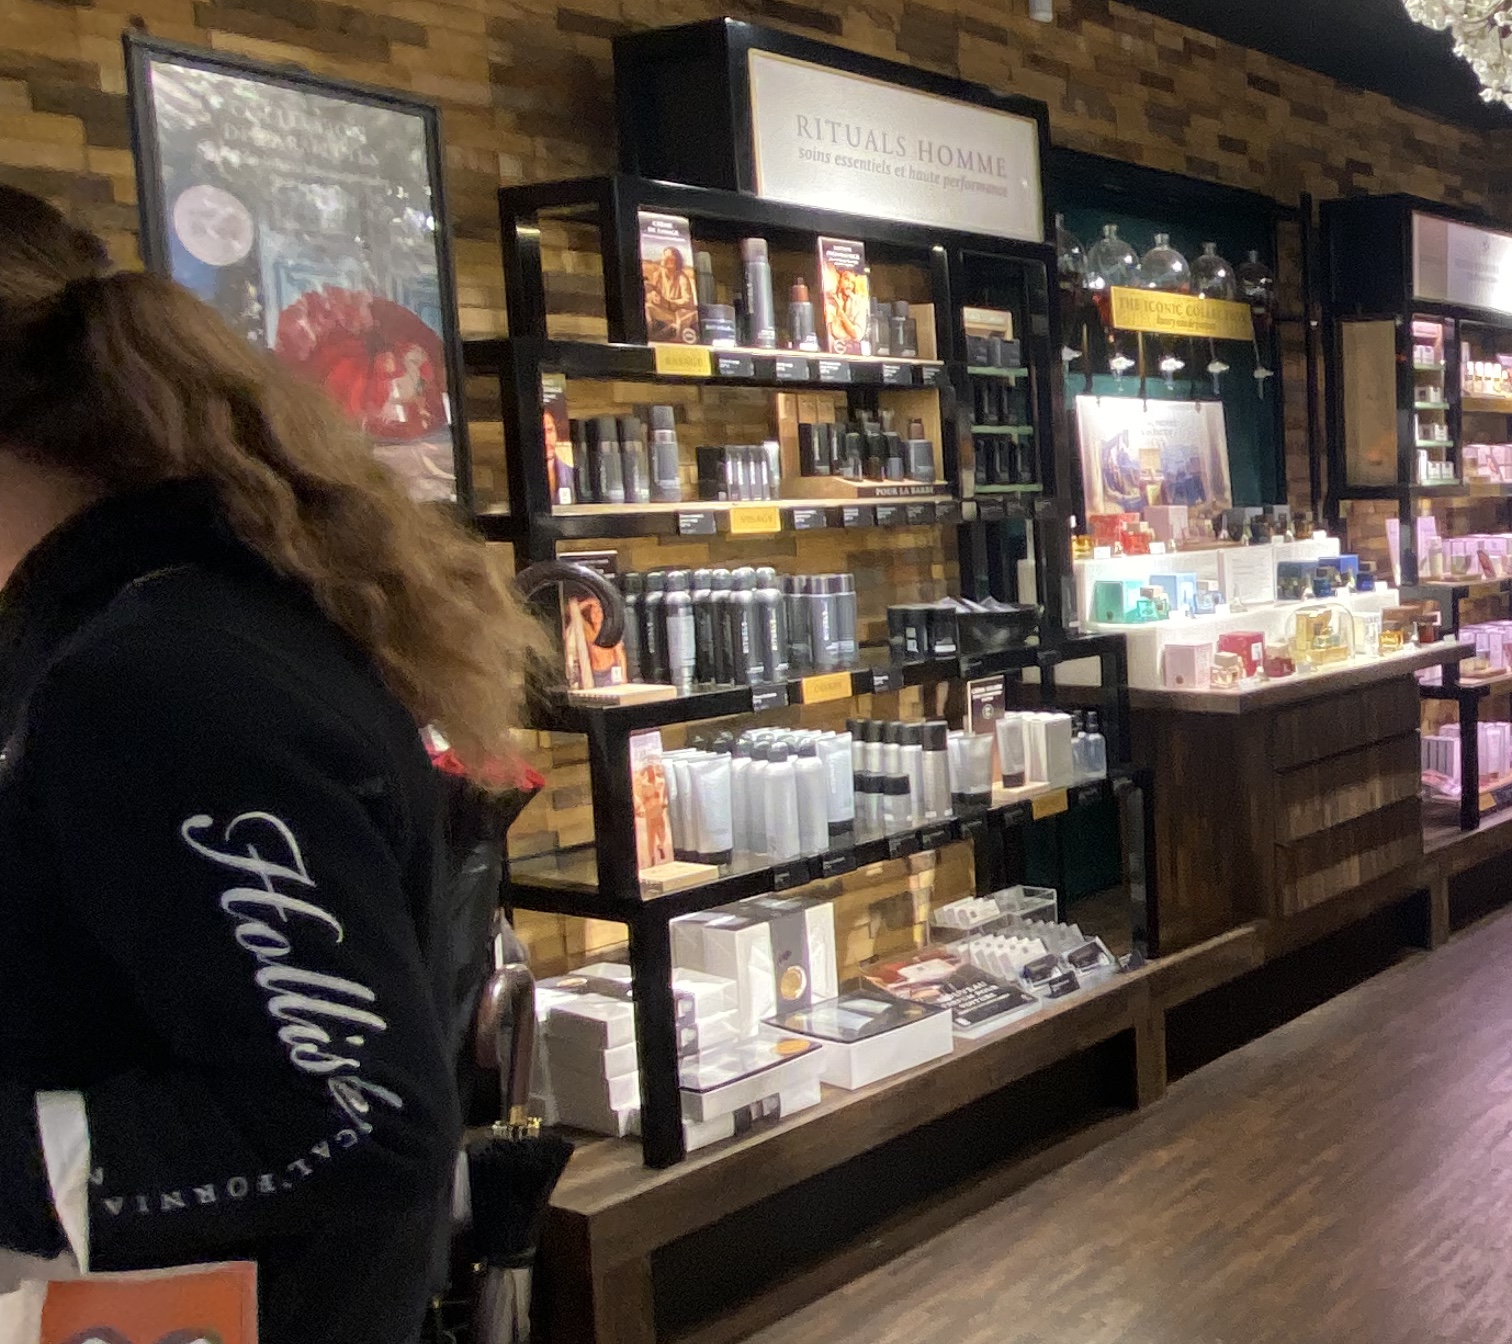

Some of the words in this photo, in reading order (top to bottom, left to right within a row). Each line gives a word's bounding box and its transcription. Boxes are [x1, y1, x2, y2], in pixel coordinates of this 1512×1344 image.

[796, 114, 906, 157] RITUALS
[917, 139, 1008, 179] HOMME
[799, 146, 832, 164] soins
[834, 152, 892, 176] essentiels
[894, 164, 905, 178] et
[908, 164, 941, 185] haute
[1120, 296, 1141, 312] THE
[1144, 299, 1184, 316] ICONIC
